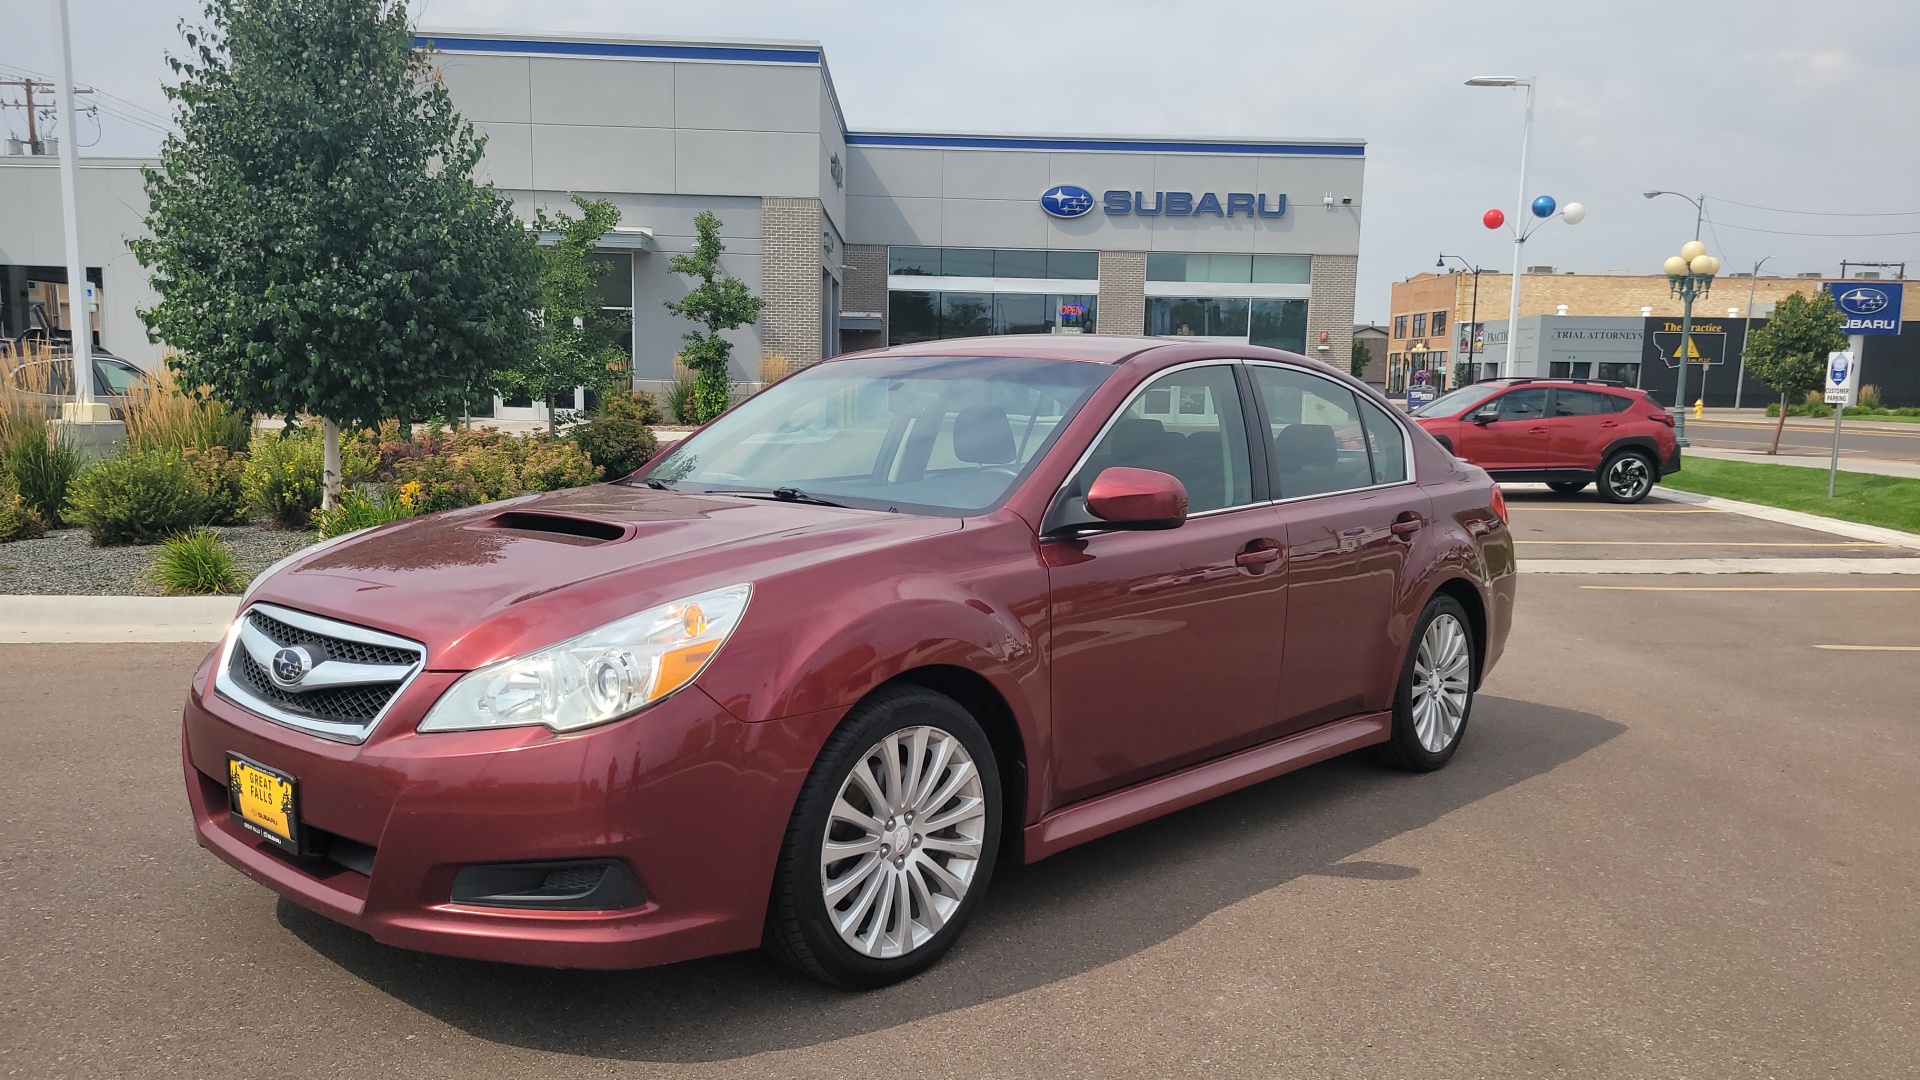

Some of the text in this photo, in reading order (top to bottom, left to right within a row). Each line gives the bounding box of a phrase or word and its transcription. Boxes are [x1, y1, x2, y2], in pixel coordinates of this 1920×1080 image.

[1103, 190, 1287, 218] SUBARU
[1060, 305, 1082, 315] OPEN
[1663, 323, 1722, 332] The ractice
[1839, 320, 1895, 329] UBARU
[1556, 331, 1643, 340] TRIAL ATTORNEYS
[249, 772, 272, 791] GREAT
[250, 786, 273, 805] FALLS
[257, 812, 278, 825] SUBARU
